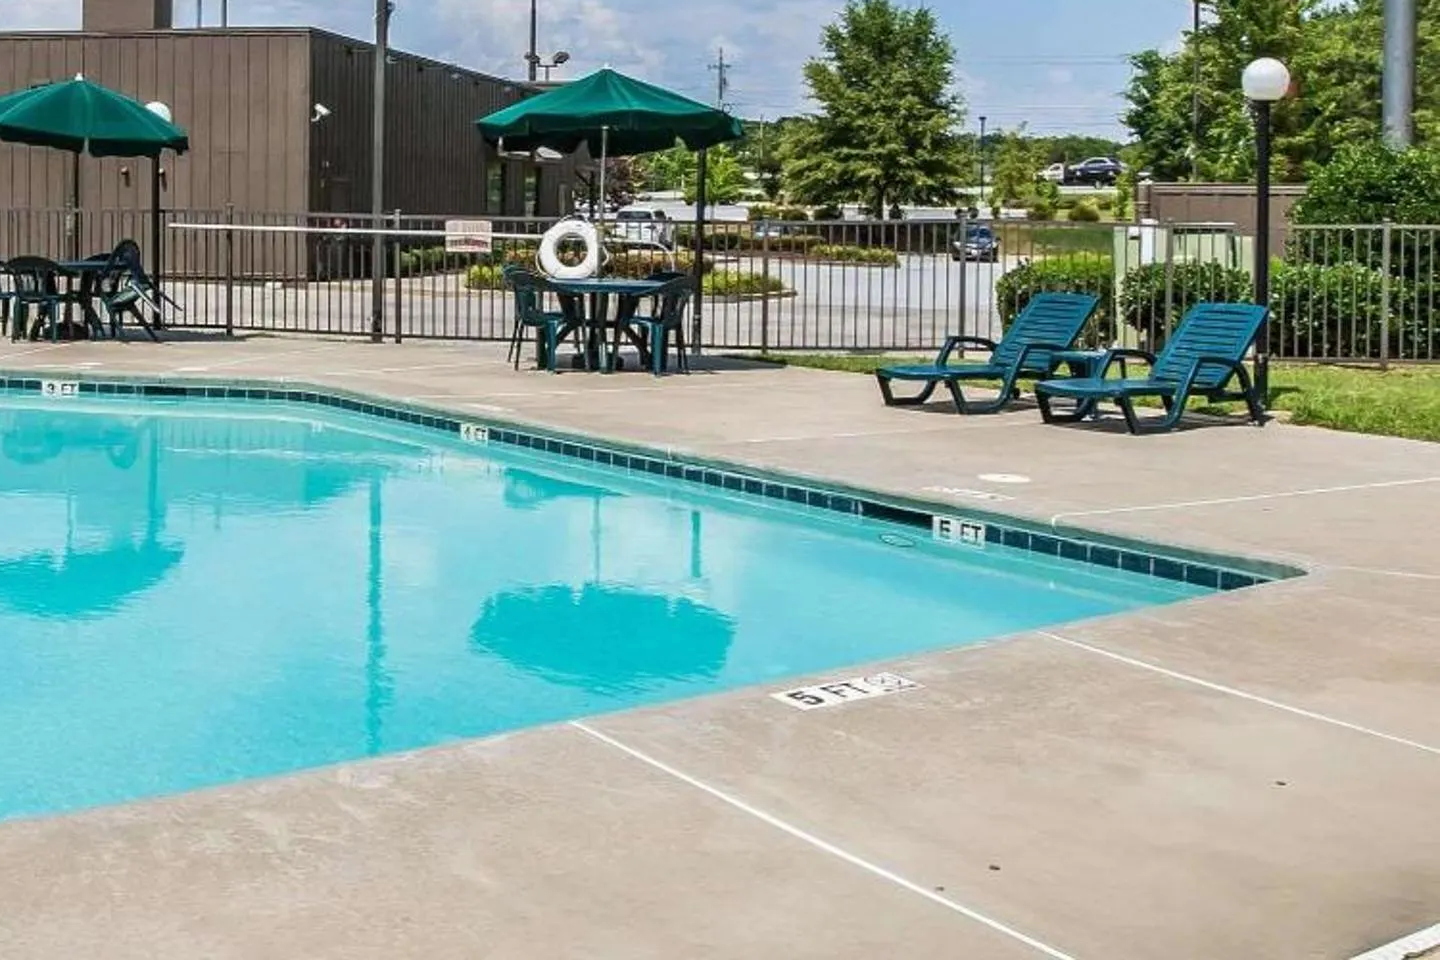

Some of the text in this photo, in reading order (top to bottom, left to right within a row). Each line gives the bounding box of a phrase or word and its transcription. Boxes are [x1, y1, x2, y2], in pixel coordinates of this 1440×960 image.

[60, 383, 78, 396] FT
[960, 523, 982, 543] FT
[786, 682, 870, 705] 5 FT
